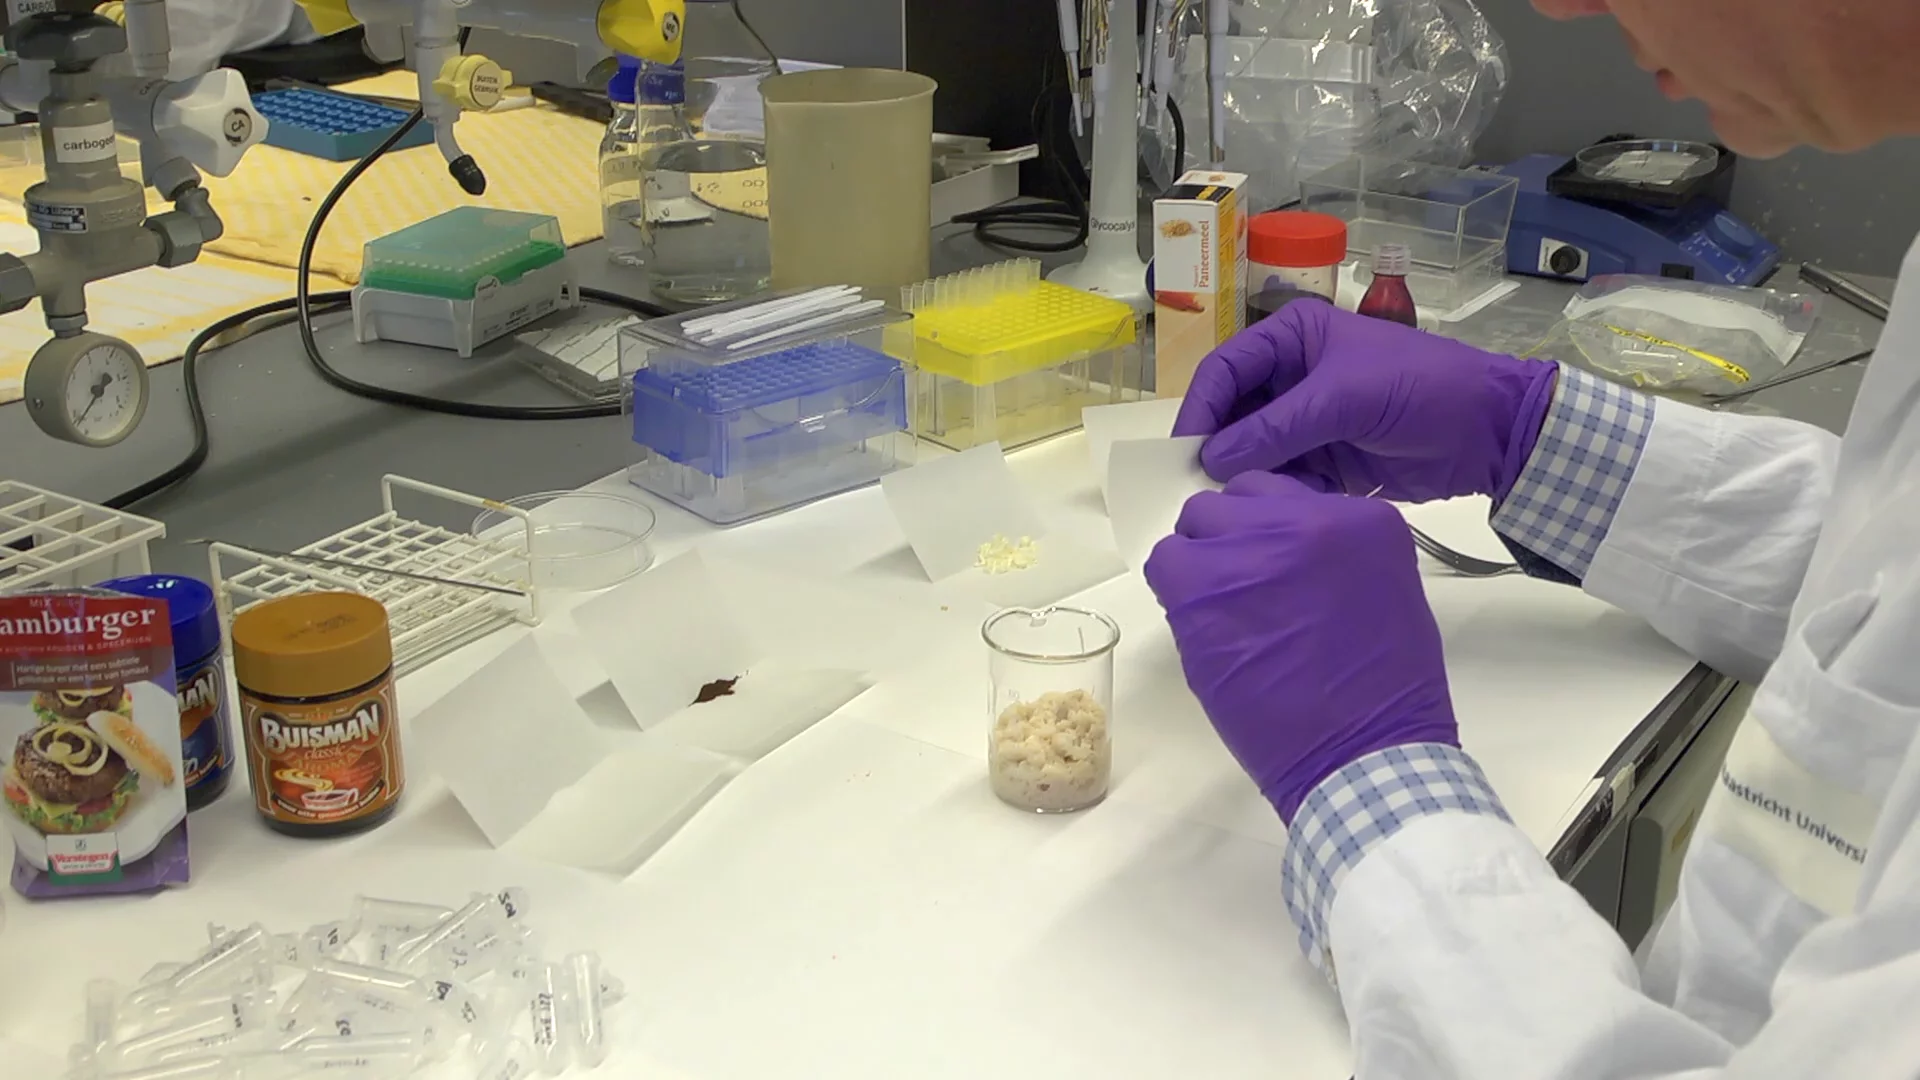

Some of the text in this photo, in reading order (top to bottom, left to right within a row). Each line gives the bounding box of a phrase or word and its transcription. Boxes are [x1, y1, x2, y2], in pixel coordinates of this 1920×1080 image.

[231, 119, 246, 132] CA
[1198, 220, 1210, 289] Paneermeel
[260, 703, 380, 754] BUISMAN
